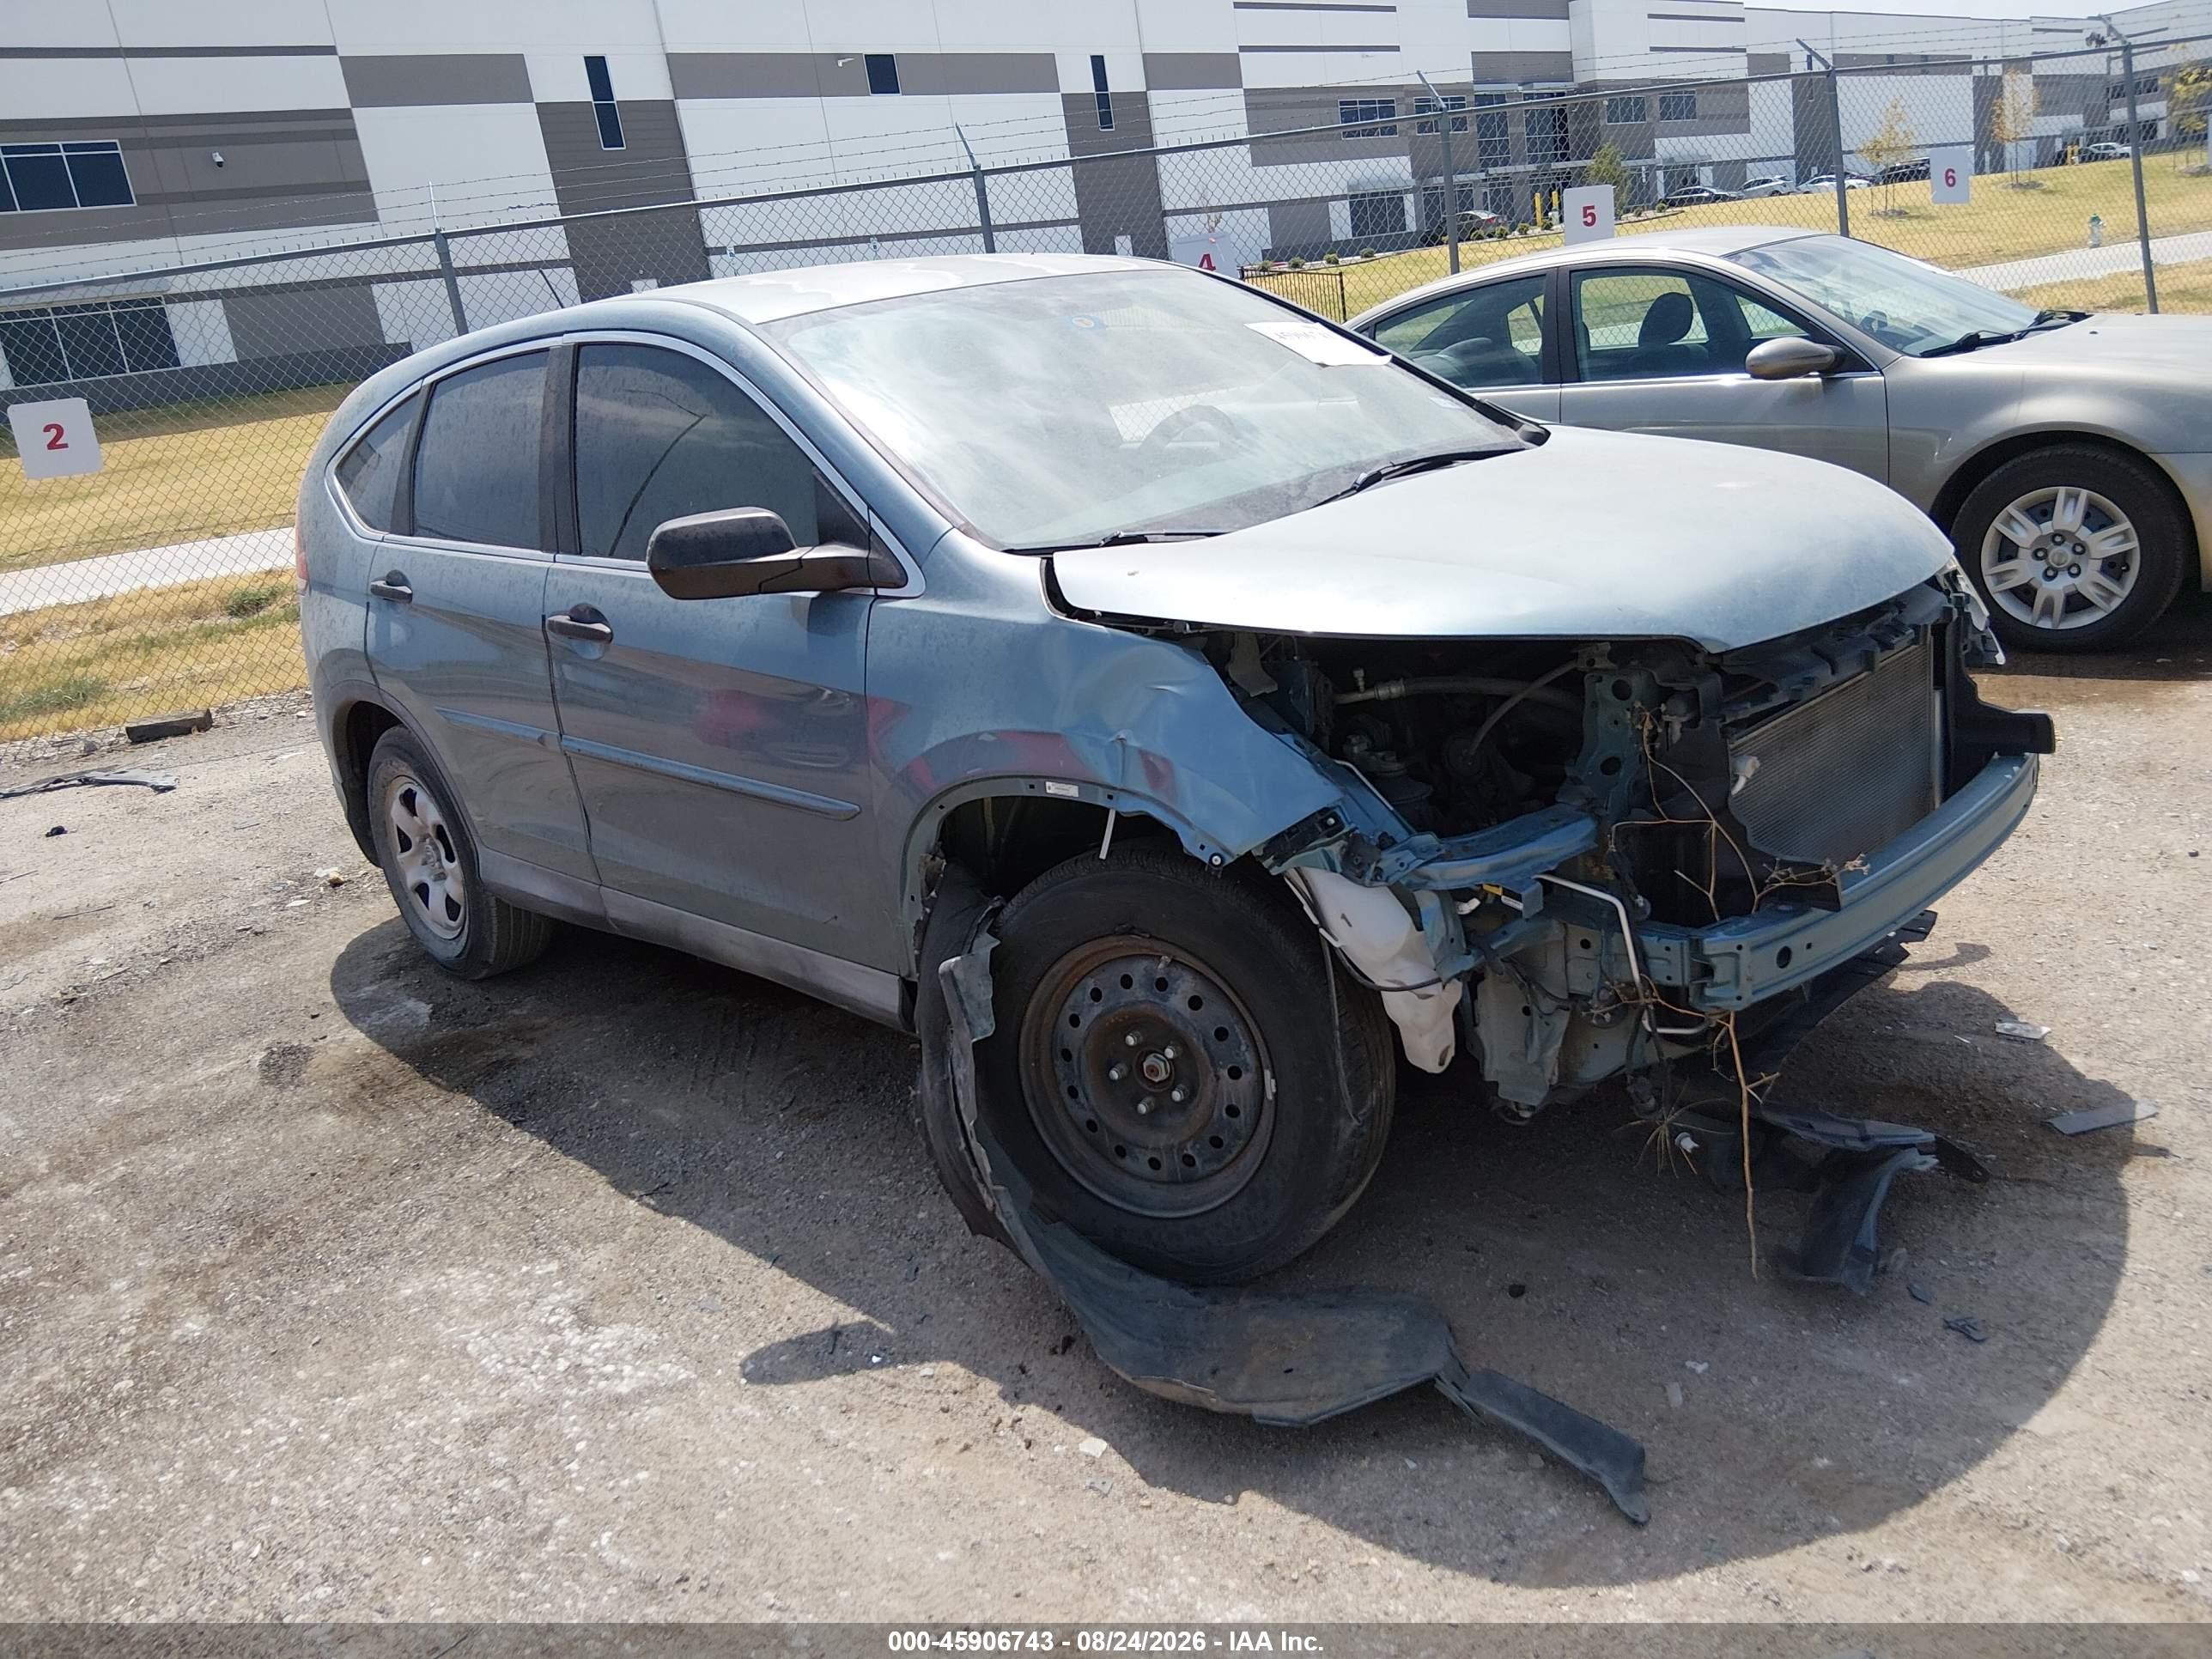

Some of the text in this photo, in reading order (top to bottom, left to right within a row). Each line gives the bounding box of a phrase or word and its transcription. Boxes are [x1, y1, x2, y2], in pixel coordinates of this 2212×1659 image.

[1945, 168, 1956, 187] 6
[1583, 205, 1596, 227] 5
[1199, 253, 1216, 271] 4
[43, 423, 69, 450] 2
